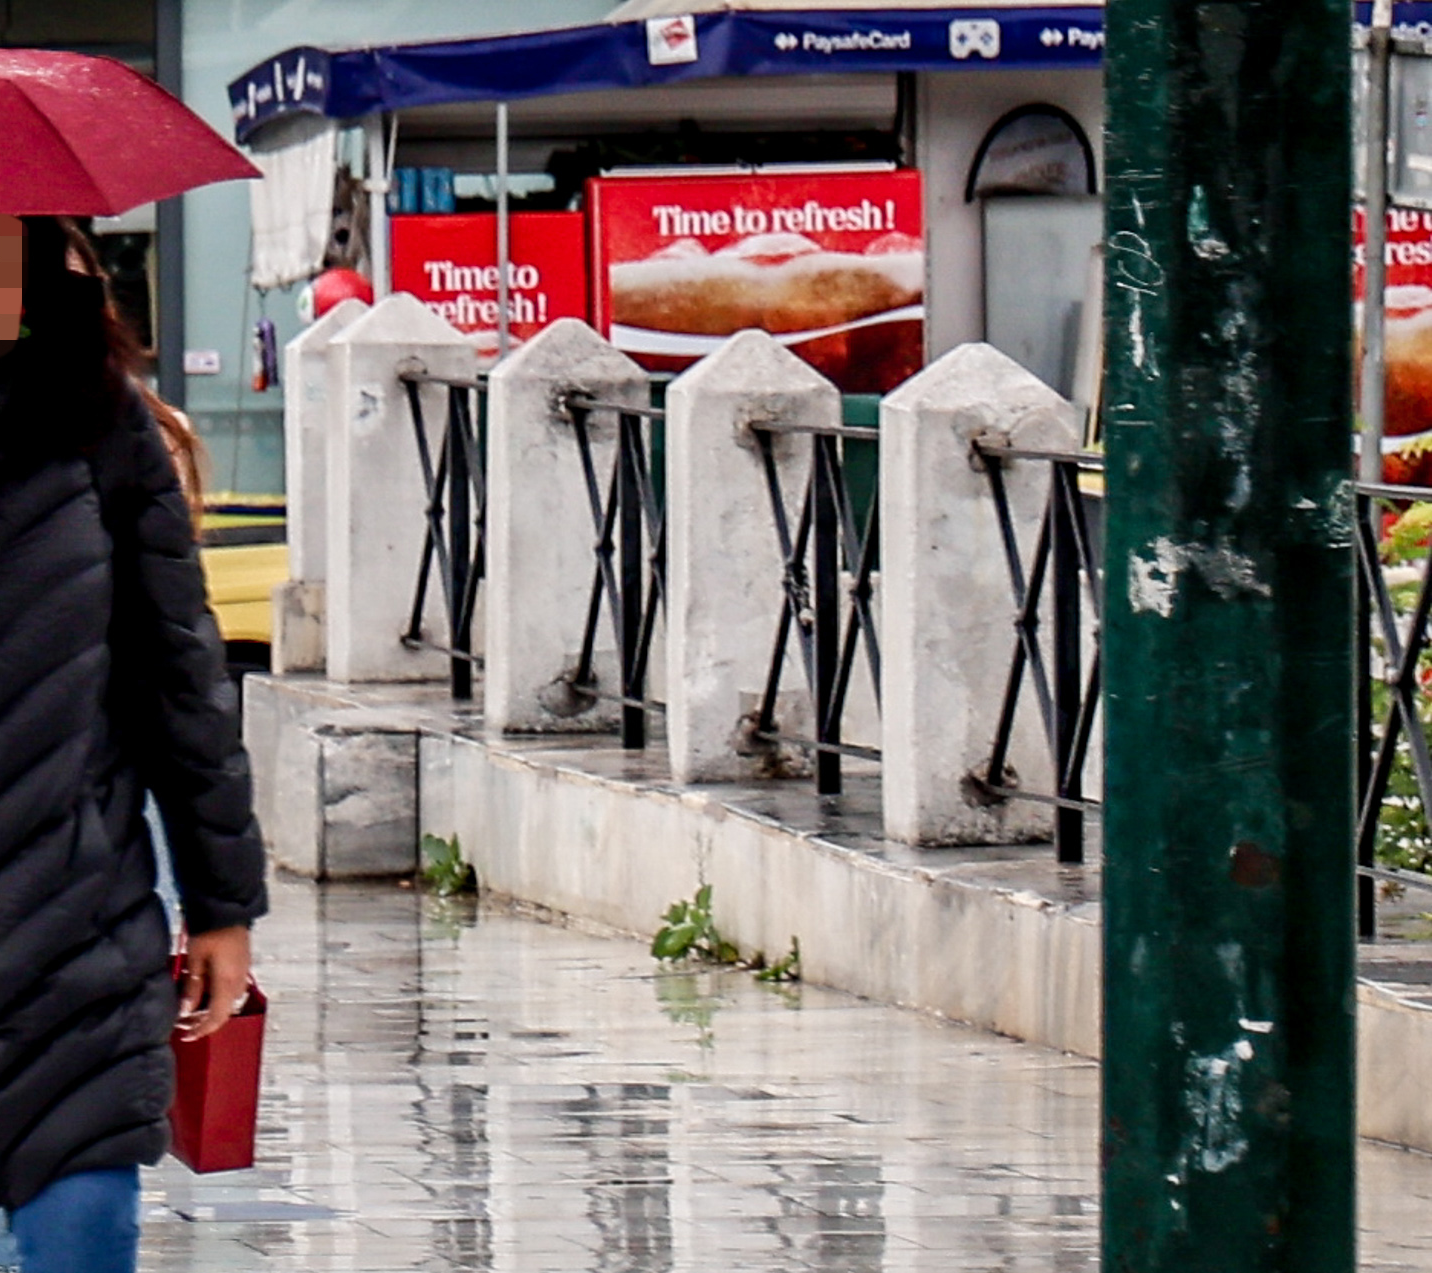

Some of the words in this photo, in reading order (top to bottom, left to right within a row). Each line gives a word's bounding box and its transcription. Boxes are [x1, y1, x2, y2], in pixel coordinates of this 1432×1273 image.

[803, 32, 911, 54] PaysafeCard
[652, 205, 731, 236] Time
[732, 205, 767, 232] to
[772, 199, 896, 232] refresh!
[423, 260, 500, 291] Time
[507, 261, 539, 290] to
